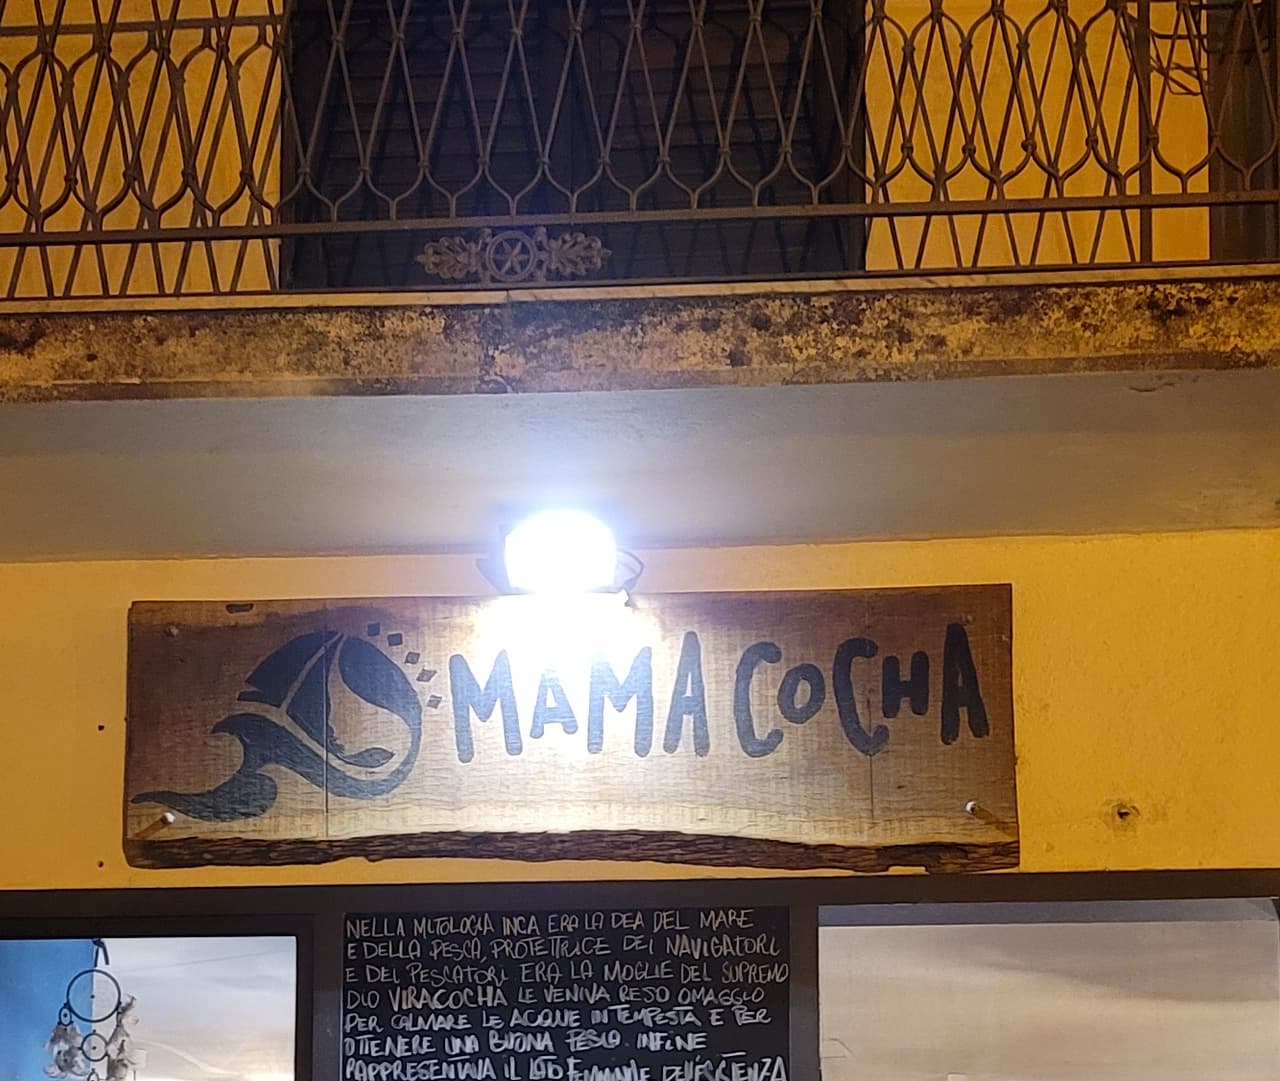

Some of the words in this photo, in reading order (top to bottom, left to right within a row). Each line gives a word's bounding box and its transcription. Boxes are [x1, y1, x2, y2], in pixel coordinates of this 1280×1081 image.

[449, 630, 710, 763] MAMA
[346, 914, 406, 939] NELLA
[413, 911, 495, 939] MITOLOGIA
[502, 915, 540, 936] INCA
[547, 911, 579, 934] ERA
[584, 911, 604, 930] LA
[611, 911, 645, 930] DEA
[653, 910, 689, 933] DEL
[700, 908, 754, 931] MARE
[346, 943, 358, 960] E
[363, 938, 421, 960] DELLA
[490, 935, 612, 960] PROTETTRICE
[623, 934, 654, 955] DEI
[666, 933, 781, 960] NAVIGATORI
[345, 966, 359, 983] E
[365, 963, 400, 984] DEI
[405, 961, 510, 988] PESCATORI
[519, 960, 564, 985] ERA
[570, 960, 594, 982] LA
[603, 959, 676, 982] MOGLIE
[680, 964, 713, 985] DEL
[721, 961, 790, 985] SUPREMO
[346, 989, 380, 1010] DIO
[388, 985, 508, 1012] VIRACOCHA
[518, 986, 537, 1004] LE
[543, 984, 611, 1004] VENIVA
[619, 985, 670, 1004] RESO
[677, 986, 765, 1007] OMAGGIO
[344, 1012, 384, 1033] PER
[390, 1012, 472, 1032] CALMARE
[482, 1009, 505, 1029] LE
[509, 1007, 581, 1028] ACQUE
[709, 1008, 725, 1027] E
[730, 1004, 772, 1026] PER
[343, 1033, 438, 1058] OTTENERE
[444, 1034, 481, 1056] UNA
[489, 1029, 555, 1055] BUONA
